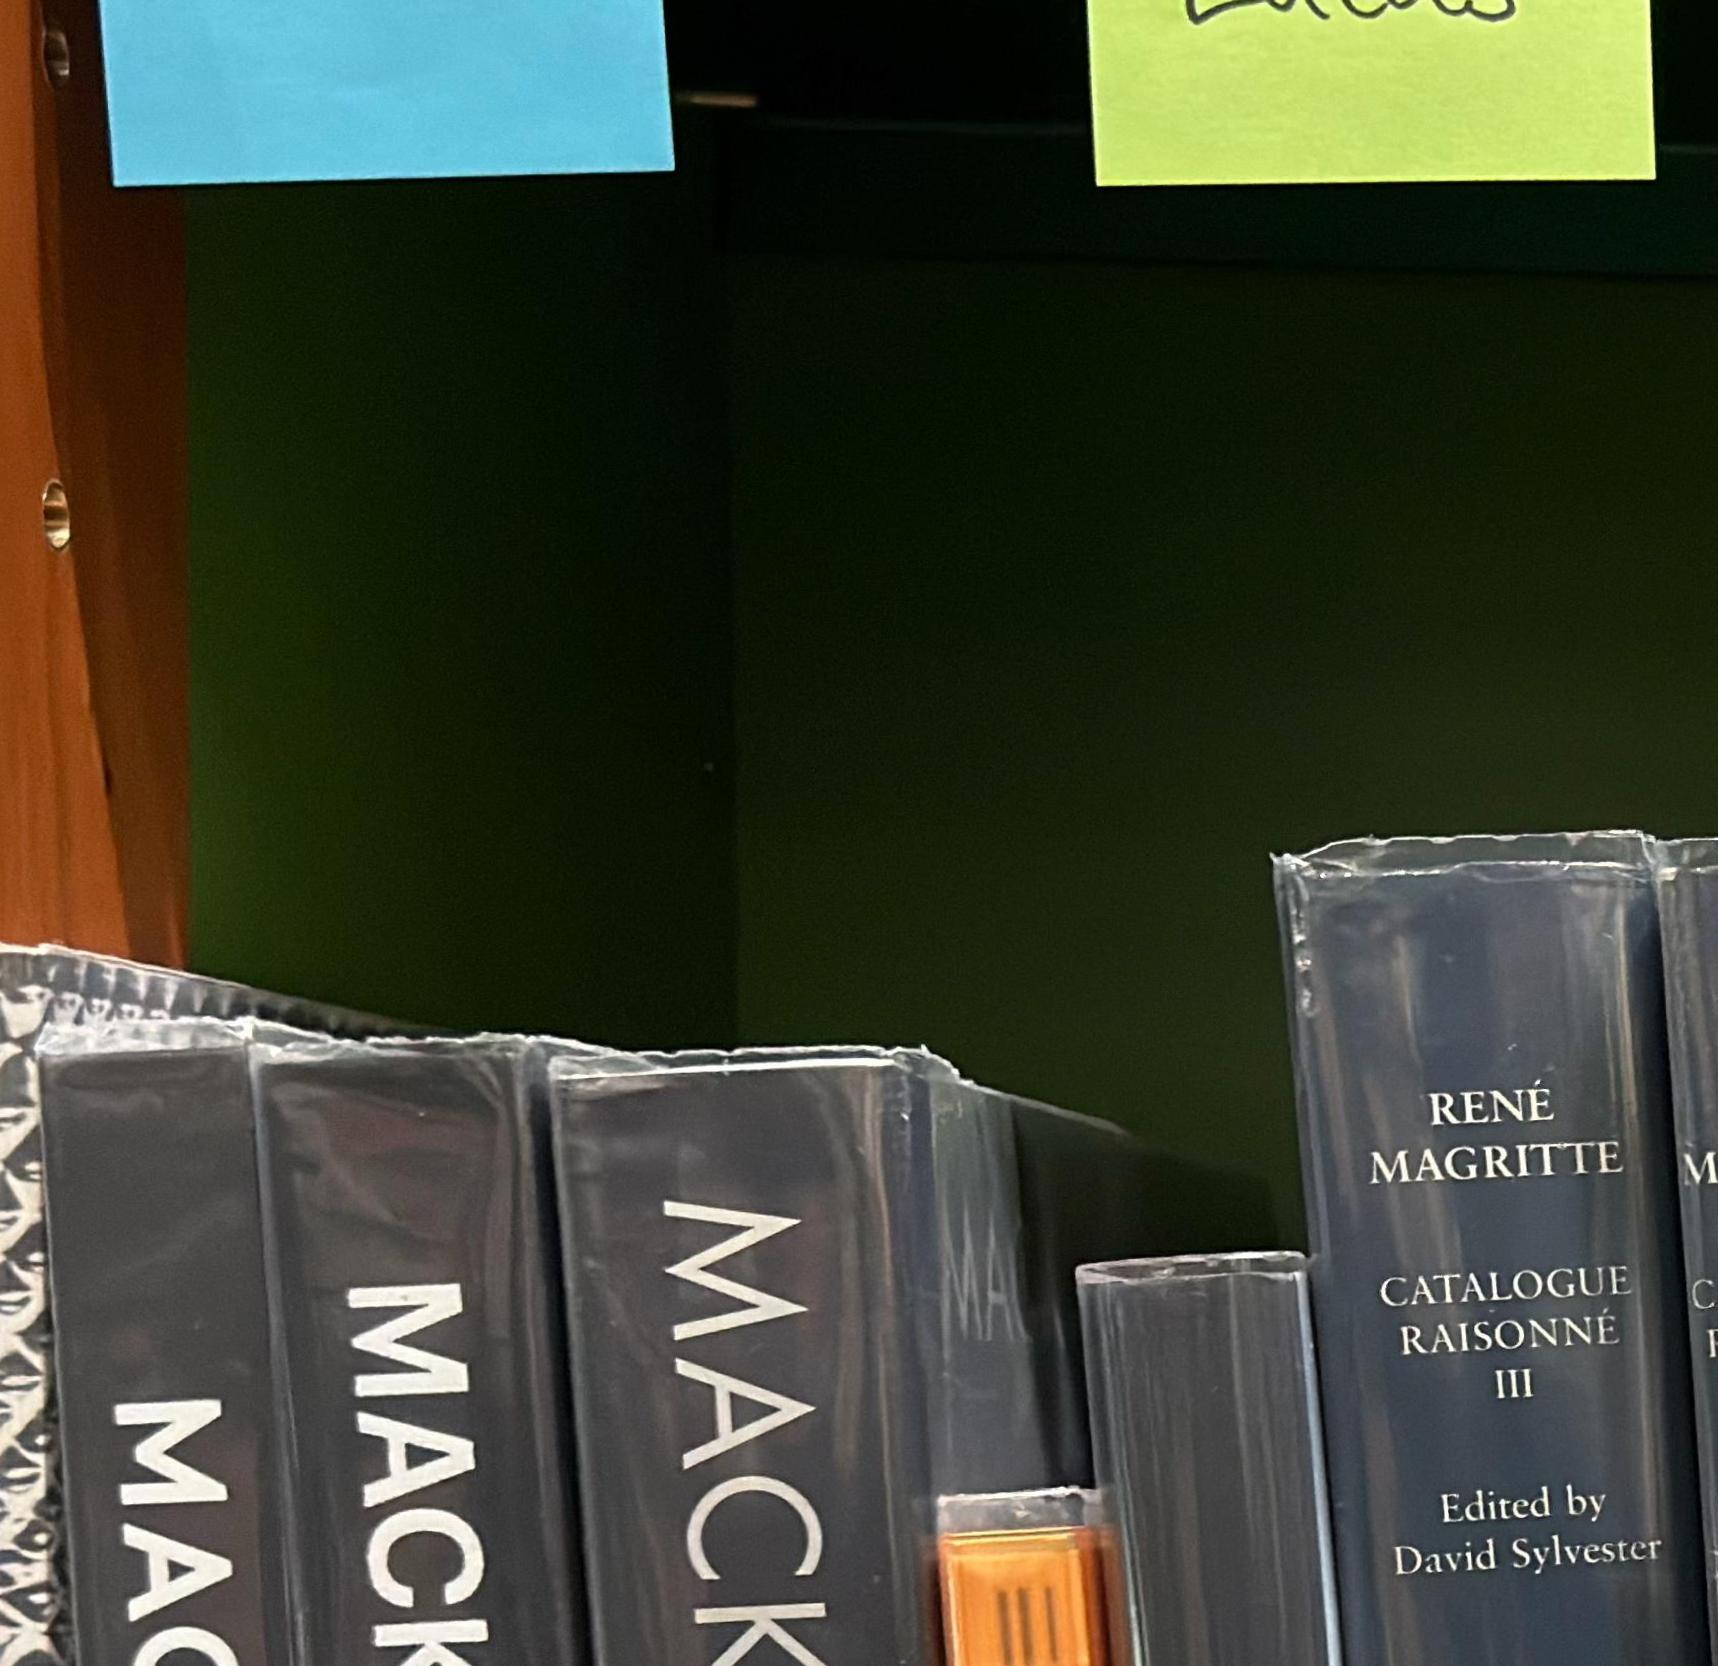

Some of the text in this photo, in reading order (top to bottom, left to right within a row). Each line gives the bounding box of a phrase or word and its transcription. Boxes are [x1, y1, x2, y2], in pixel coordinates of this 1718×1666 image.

[1430, 1080, 1554, 1126] RENÉ
[1370, 1141, 1623, 1185] MAGRITTE
[1380, 1265, 1633, 1308] CATALOGUE
[1401, 1308, 1620, 1356] RAISONNÉ
[1494, 1368, 1534, 1399] III
[1440, 1484, 1607, 1524] Edited by
[1395, 1534, 1662, 1578] David Sylvester
